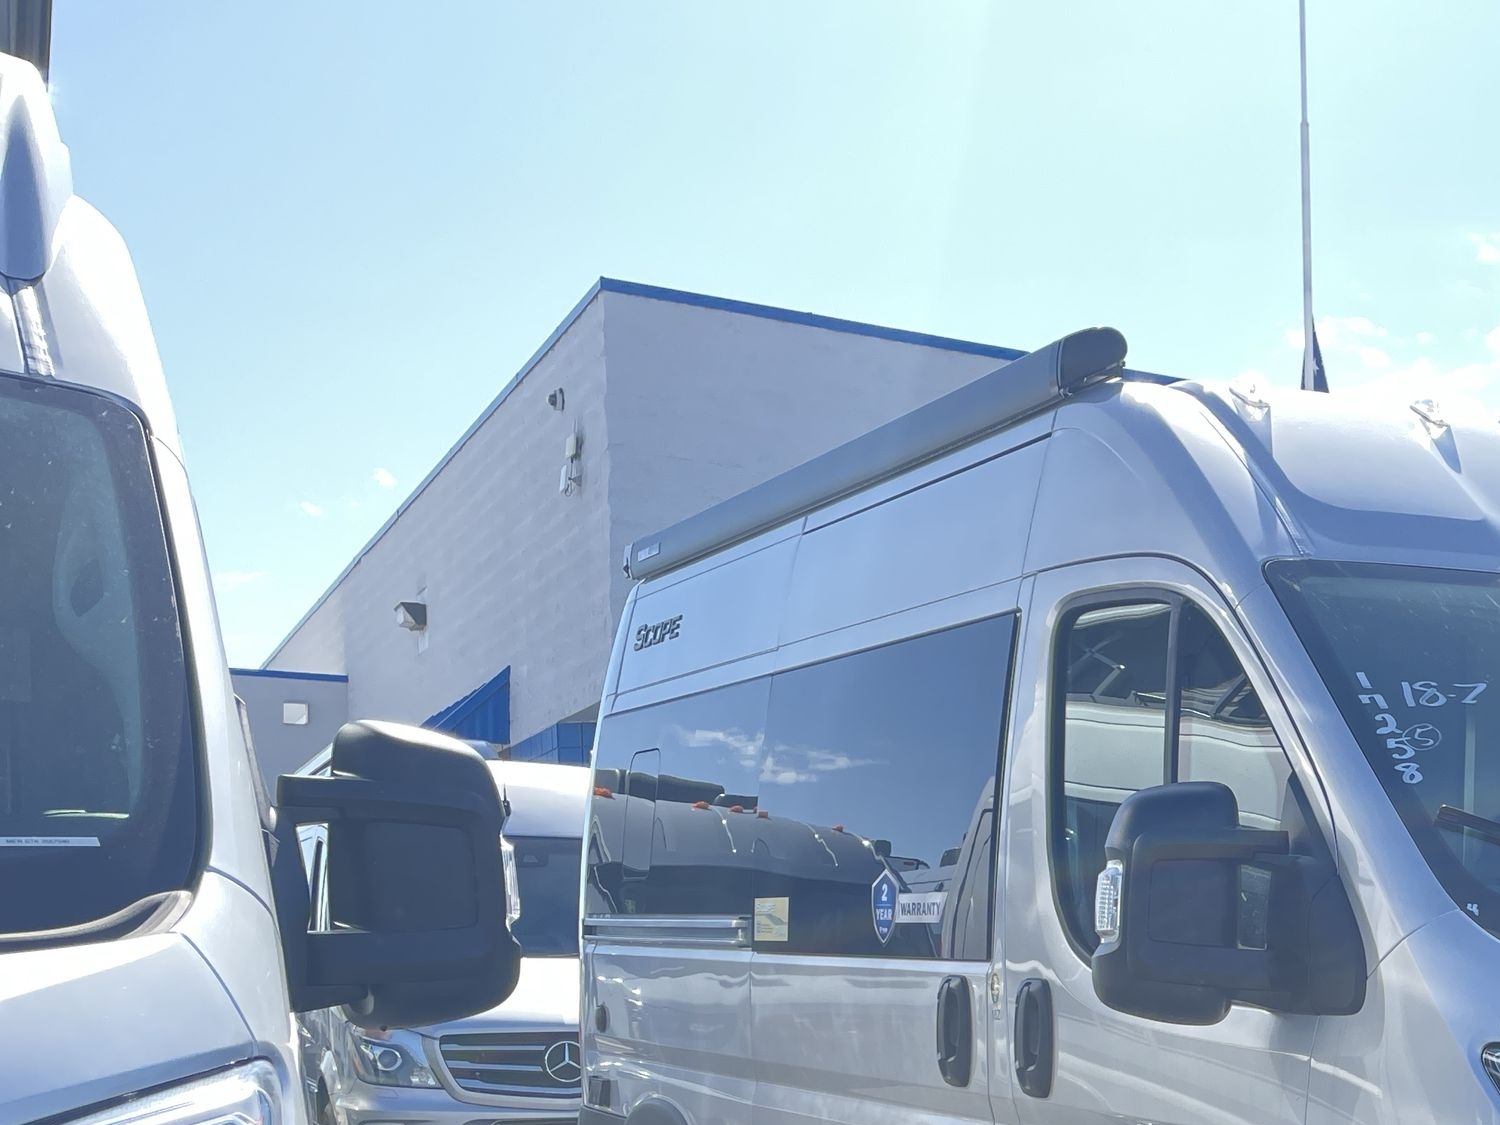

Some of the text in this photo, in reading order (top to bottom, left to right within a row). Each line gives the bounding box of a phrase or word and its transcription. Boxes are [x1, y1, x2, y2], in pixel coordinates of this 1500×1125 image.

[881, 883, 889, 902] 2
[876, 908, 893, 921] YEAR
[900, 901, 941, 916] WARRANTY
